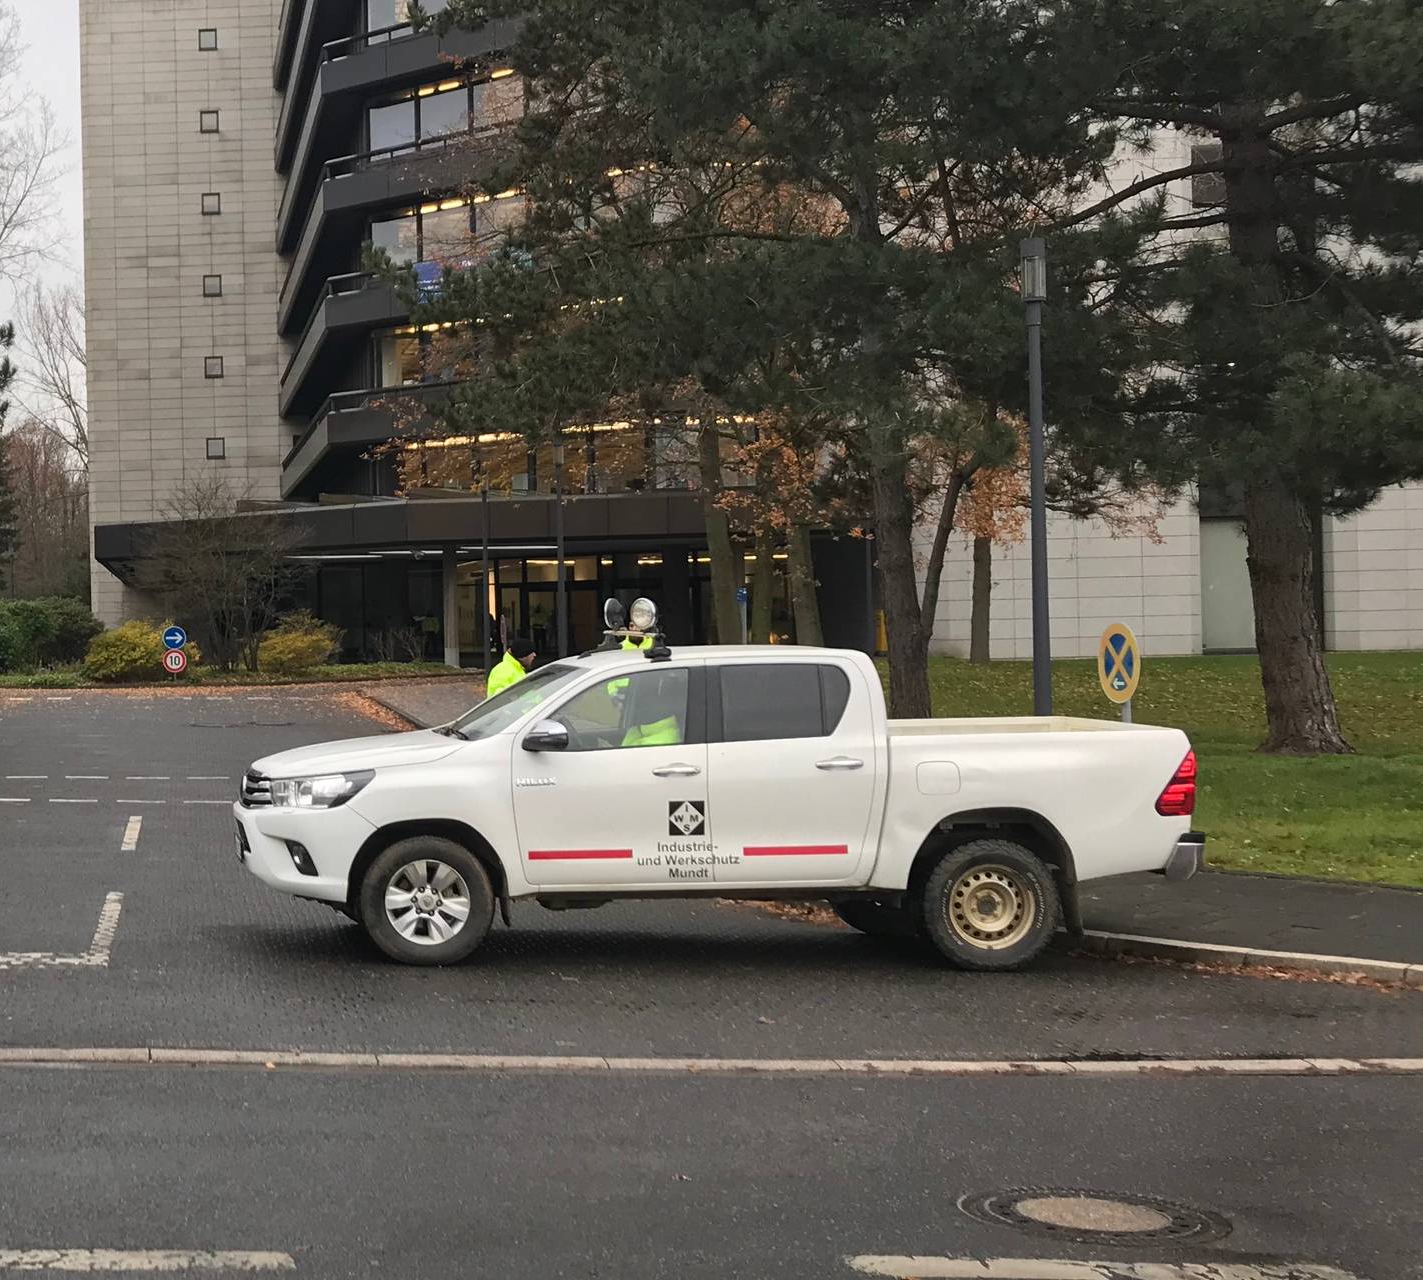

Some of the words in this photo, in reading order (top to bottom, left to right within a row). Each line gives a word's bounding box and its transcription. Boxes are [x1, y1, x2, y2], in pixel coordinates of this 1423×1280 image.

[169, 655, 181, 666] 10
[657, 841, 719, 853] Industrie-
[637, 855, 661, 866] und
[664, 853, 740, 866] Werkschutz
[668, 867, 709, 878] Mundt
